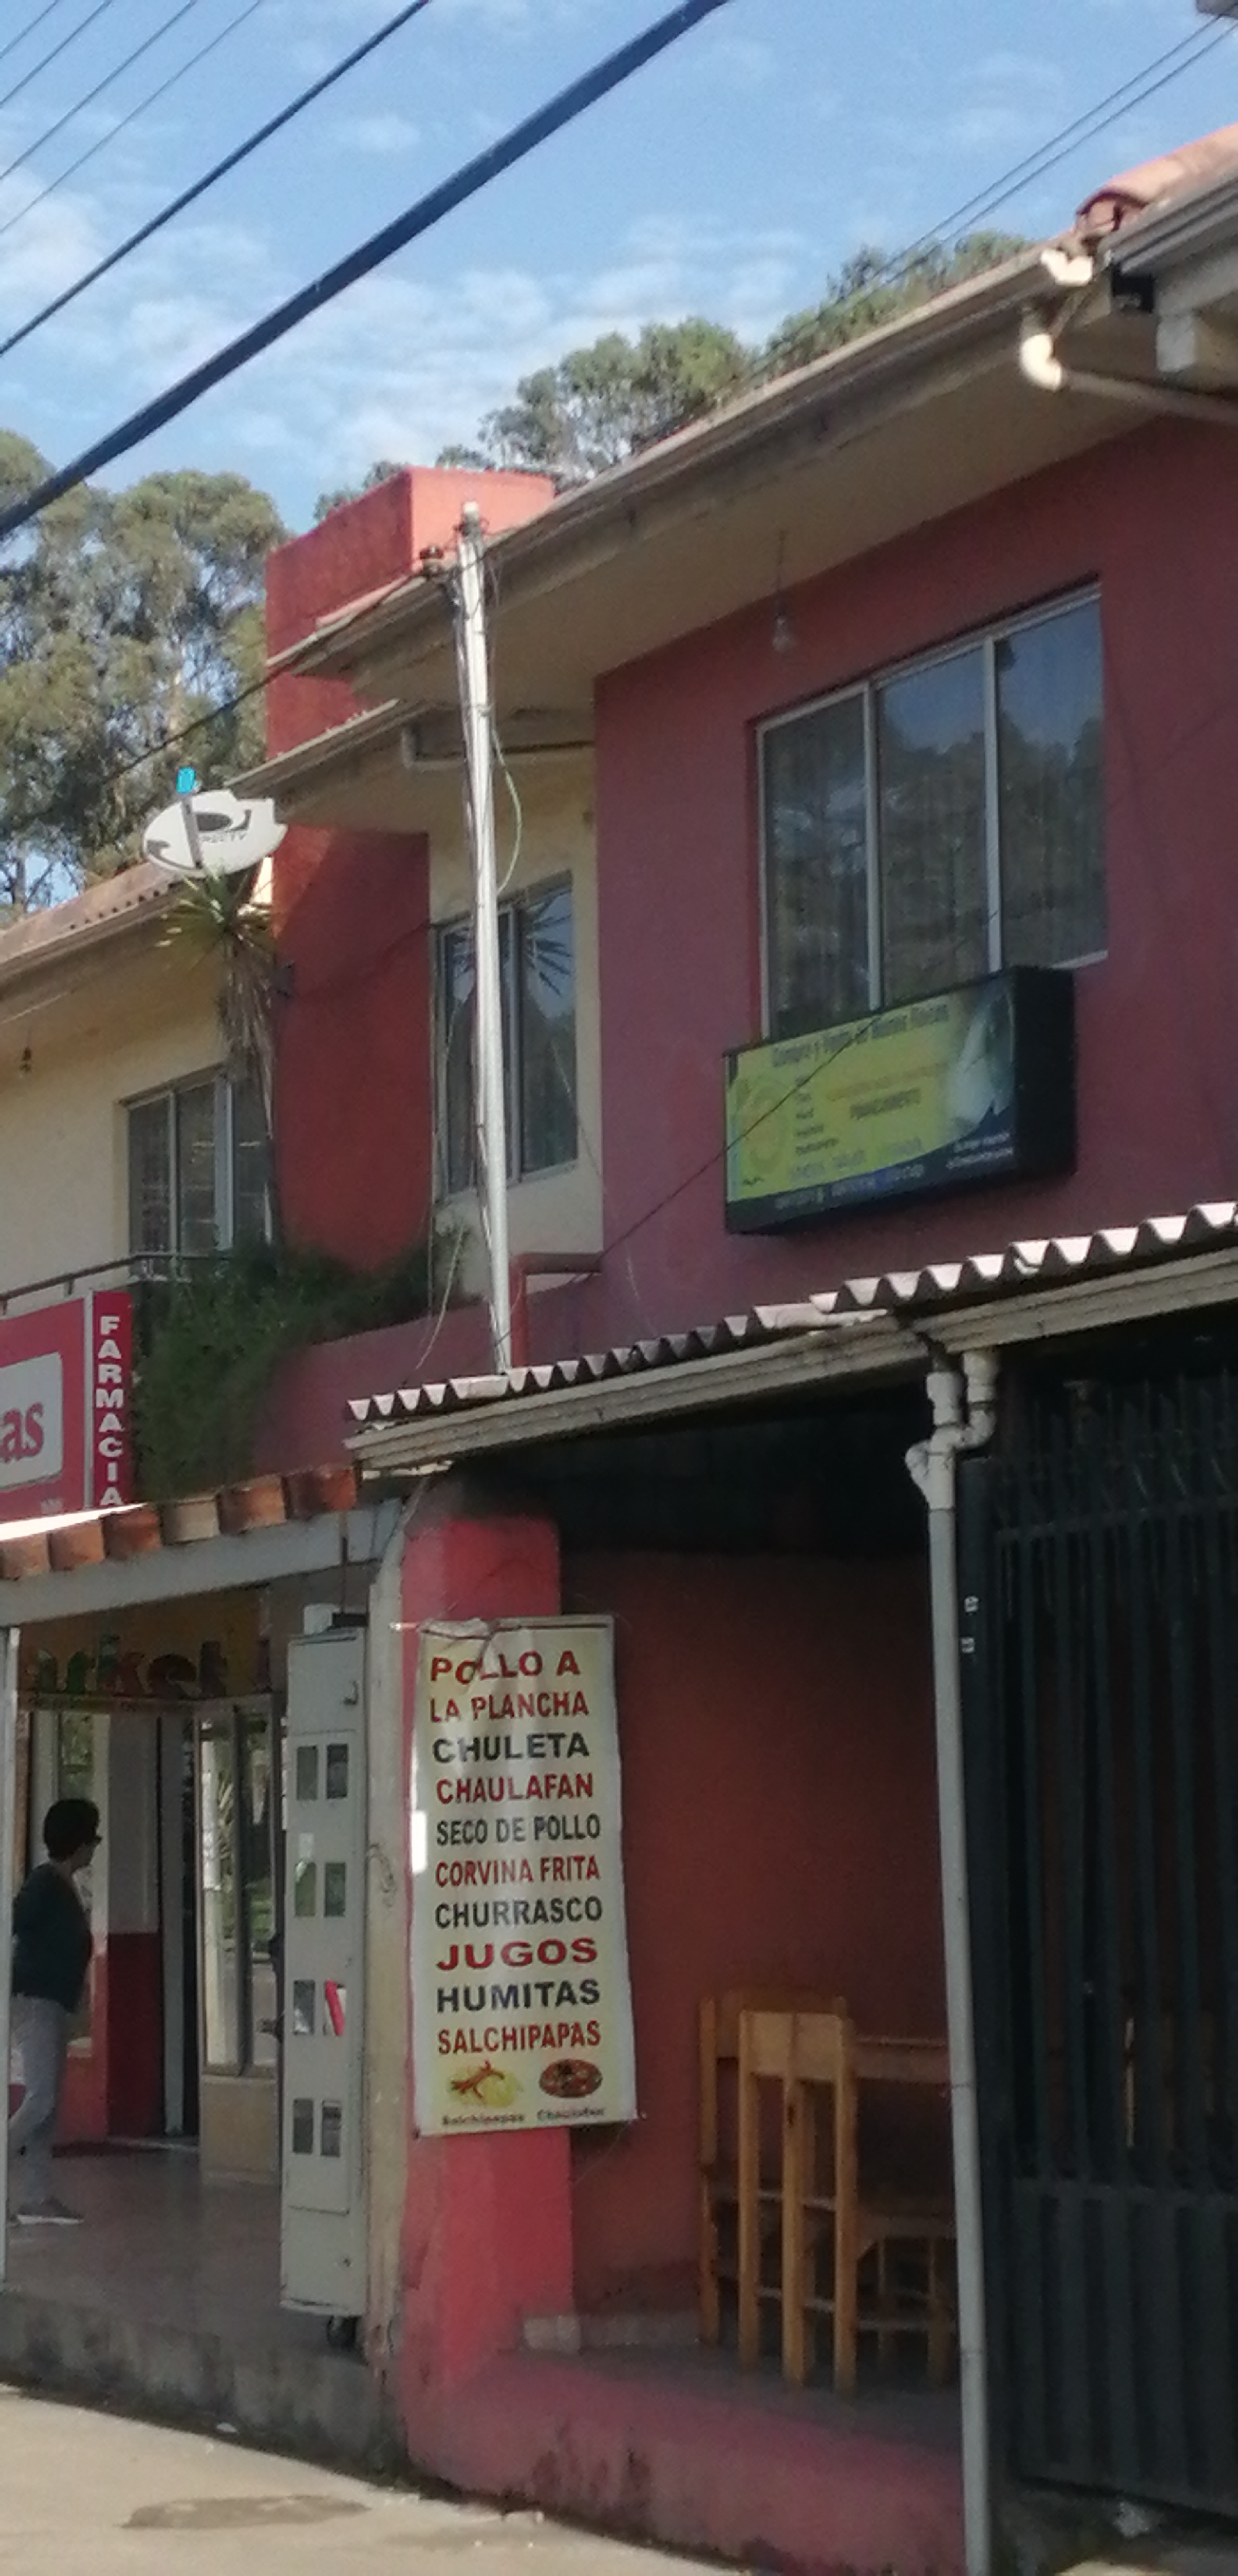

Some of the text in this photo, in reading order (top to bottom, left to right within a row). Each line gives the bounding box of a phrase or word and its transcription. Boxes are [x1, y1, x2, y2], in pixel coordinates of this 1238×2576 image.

[95, 1315, 124, 1507] FARMACIA
[431, 1650, 581, 1685] POLLO A
[430, 1690, 589, 1723] LA PLANCHA
[433, 1732, 589, 1764] CHULETA
[436, 1772, 593, 1804] CHAULAFAN
[436, 1812, 600, 1846] SECO DE POLLO
[436, 1855, 601, 1887] CORVINA FRITA
[435, 1895, 603, 1929] CHURRASCO
[436, 1937, 597, 1971] JUGOS
[436, 1978, 600, 2013] HUMITAS
[438, 2020, 601, 2055] SALCHIPAPAS
